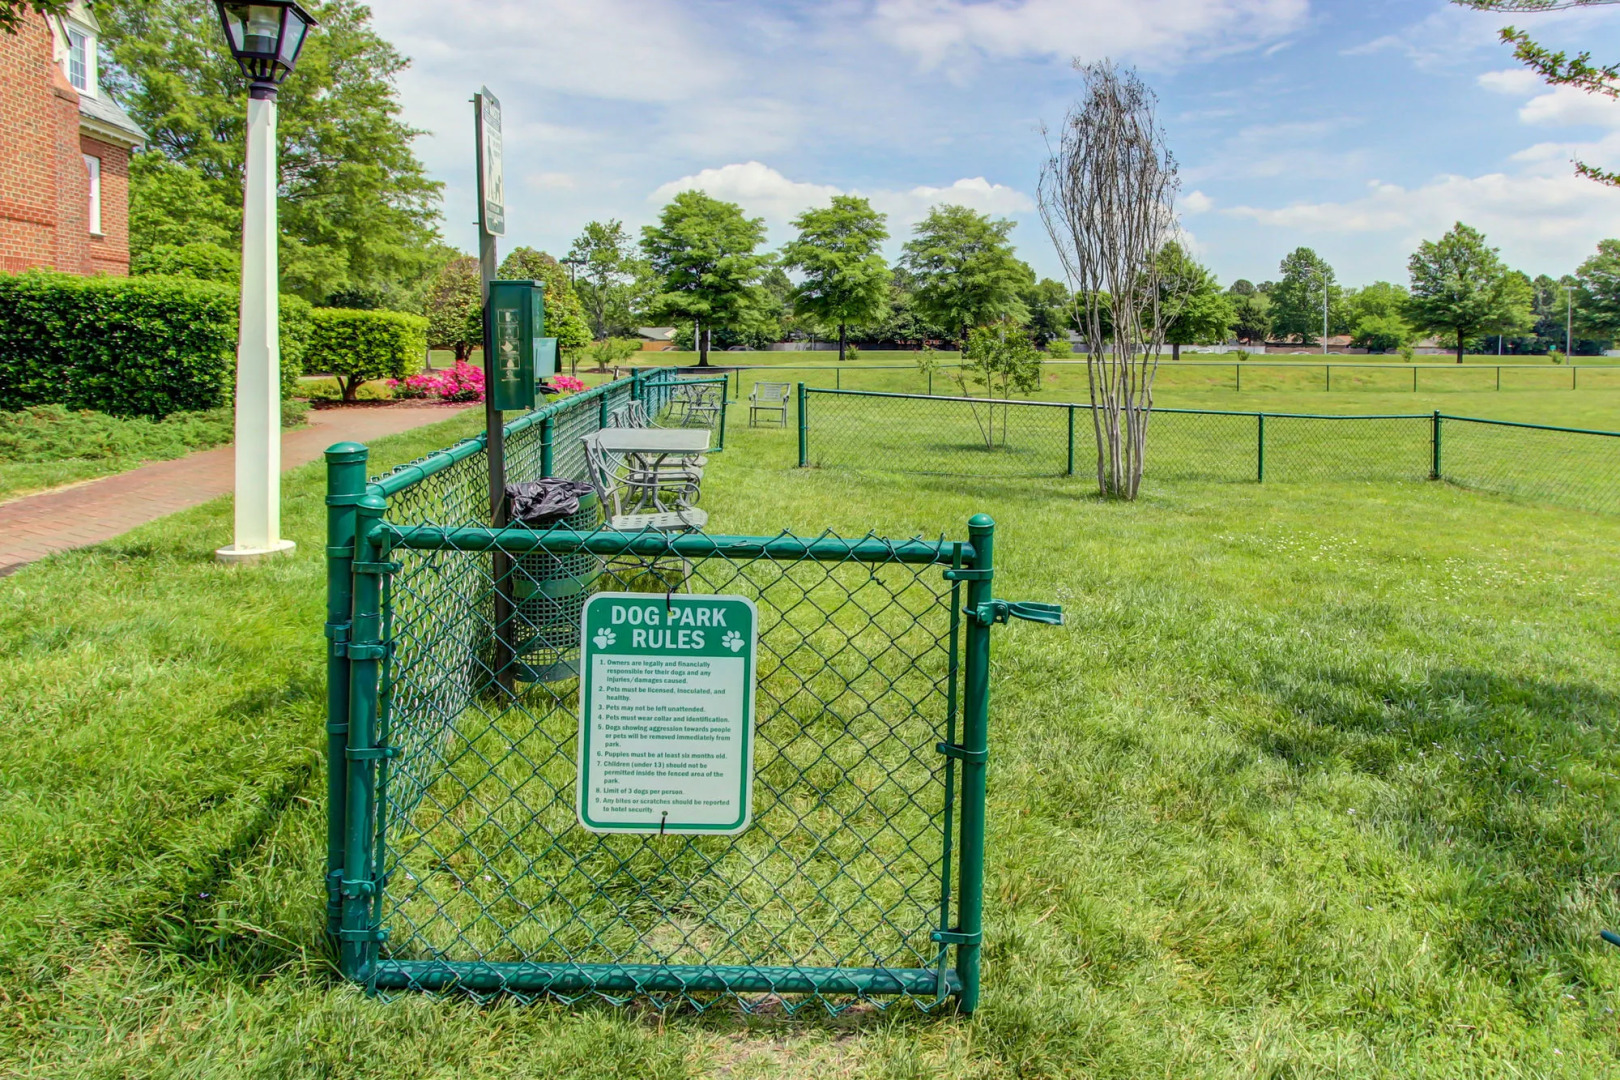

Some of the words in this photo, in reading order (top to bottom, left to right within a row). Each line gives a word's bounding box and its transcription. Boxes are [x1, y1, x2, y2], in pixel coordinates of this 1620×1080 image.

[611, 605, 660, 625] DOG
[667, 607, 727, 627] PARK
[632, 628, 705, 649] RULES
